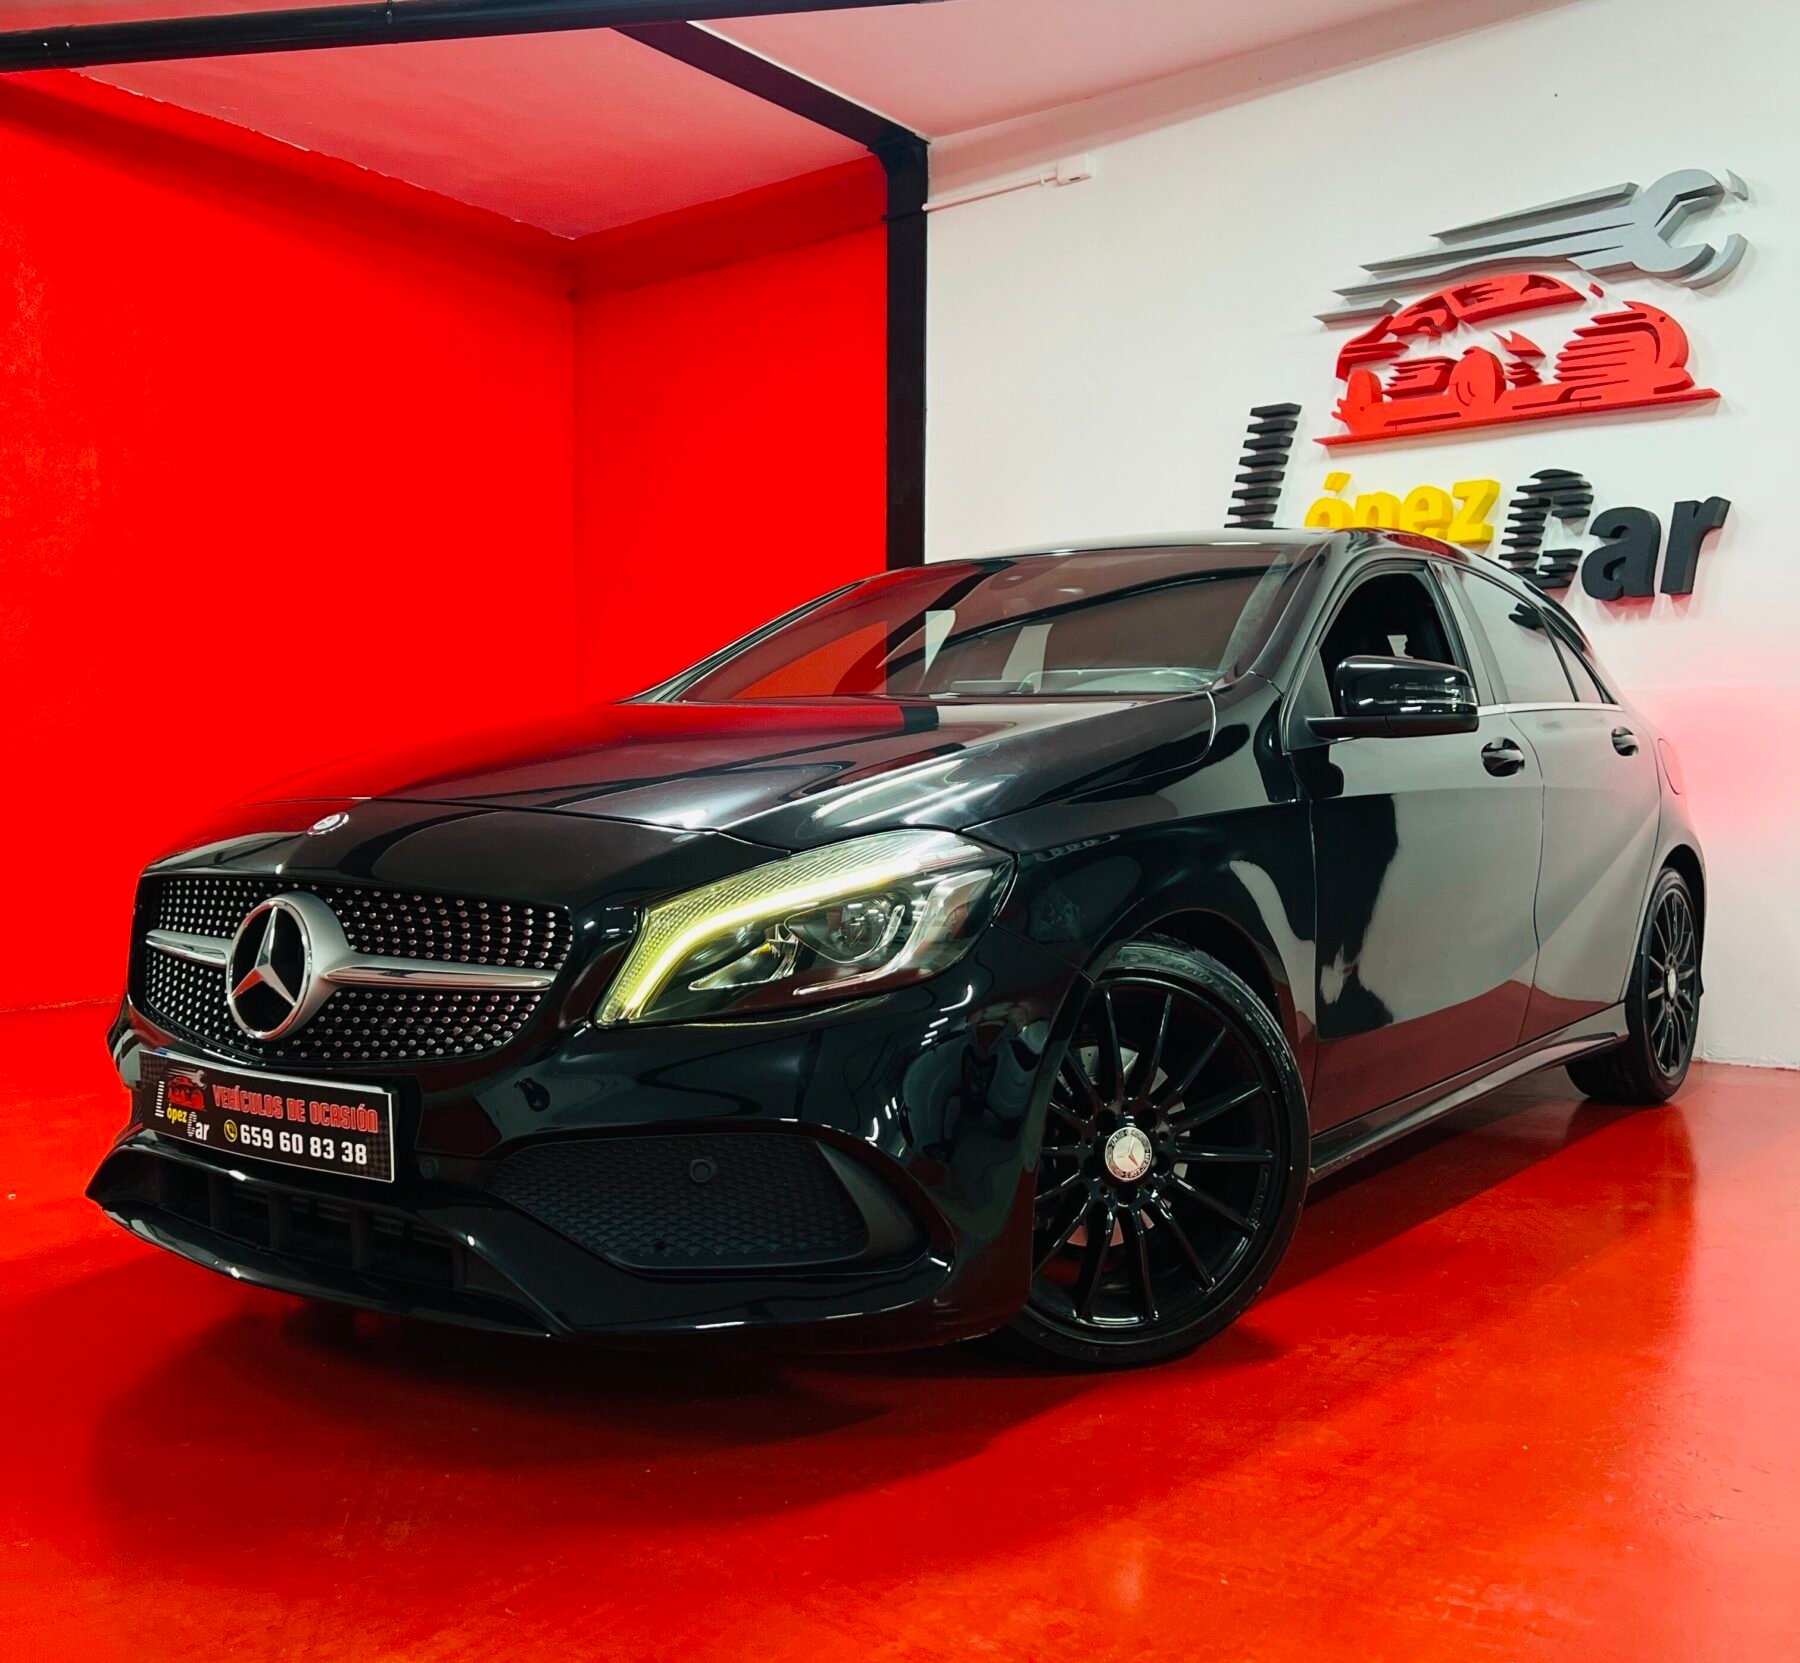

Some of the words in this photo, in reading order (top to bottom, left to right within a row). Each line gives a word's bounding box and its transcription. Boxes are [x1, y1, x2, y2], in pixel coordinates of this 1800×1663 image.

[1498, 468, 1732, 601] Car
[186, 1111, 210, 1141] Car
[212, 1084, 283, 1120] VEHÍCULOS
[287, 1099, 306, 1123] DE
[309, 1102, 379, 1134] OCASIÓN
[240, 1123, 274, 1149] 659
[279, 1131, 303, 1154] 60
[310, 1137, 335, 1160] 83
[341, 1141, 368, 1165] 38
